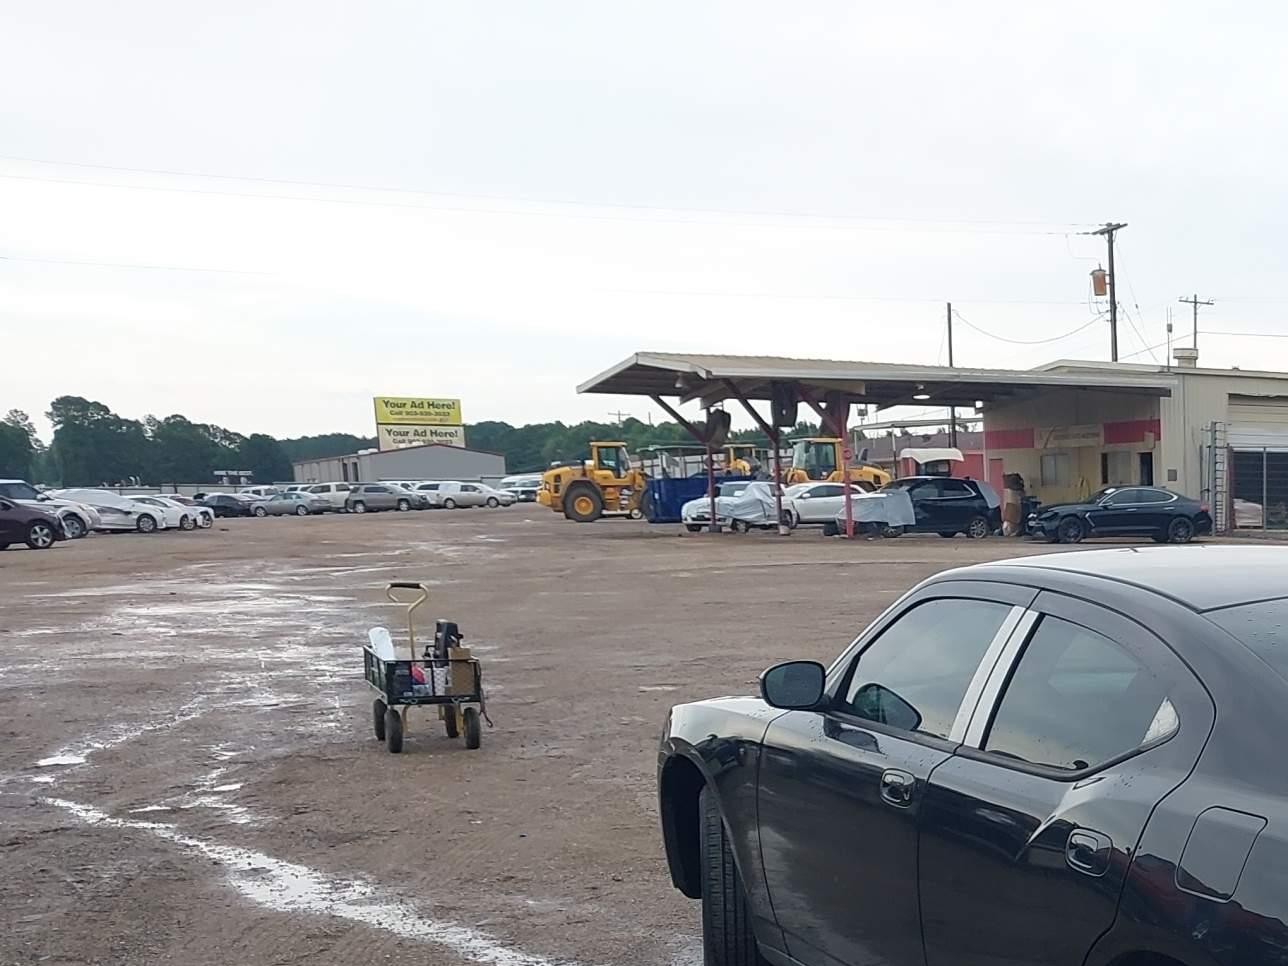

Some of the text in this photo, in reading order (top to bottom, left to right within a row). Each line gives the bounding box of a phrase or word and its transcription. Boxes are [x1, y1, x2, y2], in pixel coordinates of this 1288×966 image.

[383, 400, 455, 410] Your Ad Here!
[385, 428, 458, 438] Your Ad Here!
